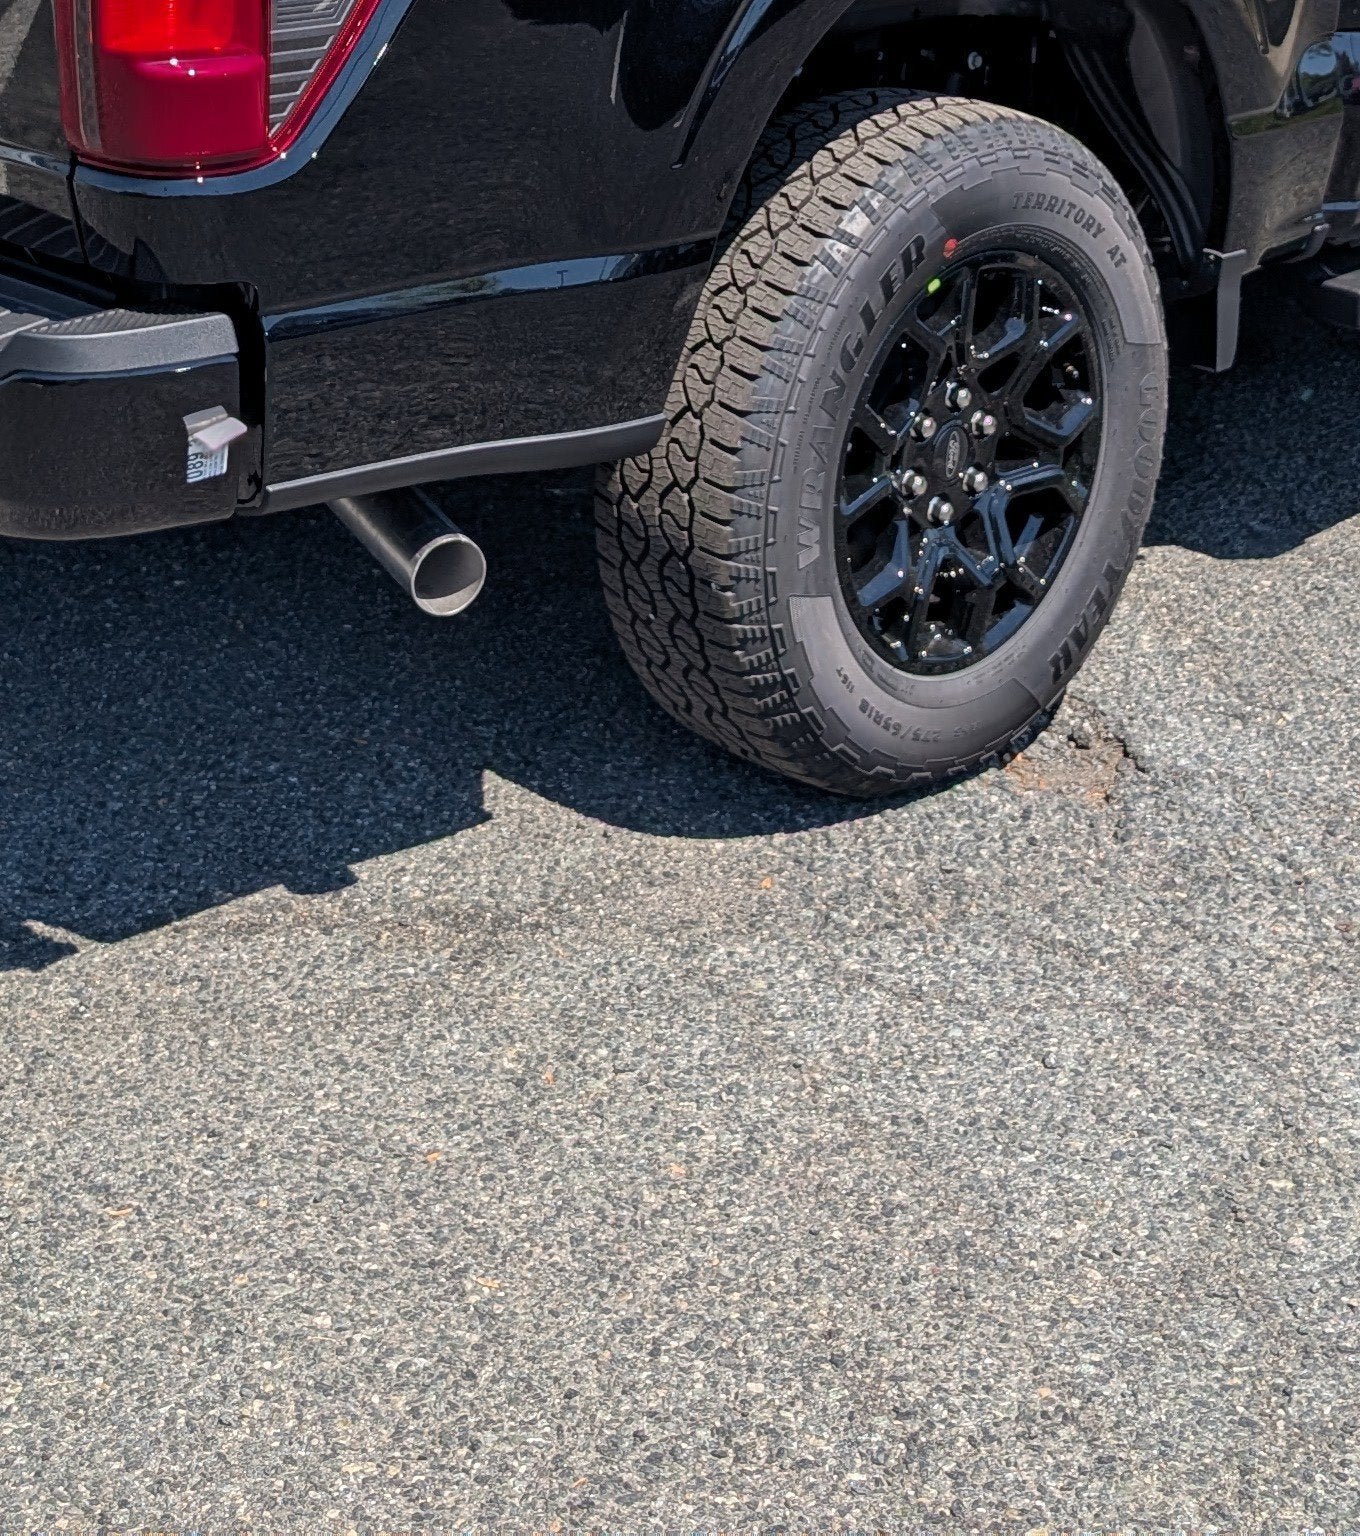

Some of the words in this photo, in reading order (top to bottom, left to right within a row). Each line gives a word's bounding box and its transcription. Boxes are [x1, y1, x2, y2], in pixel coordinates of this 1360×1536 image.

[1011, 191, 1106, 239] TERRITORY
[1106, 244, 1127, 268] AT
[796, 233, 926, 570] WRANGLER
[1047, 371, 1159, 686] GOODYEAR
